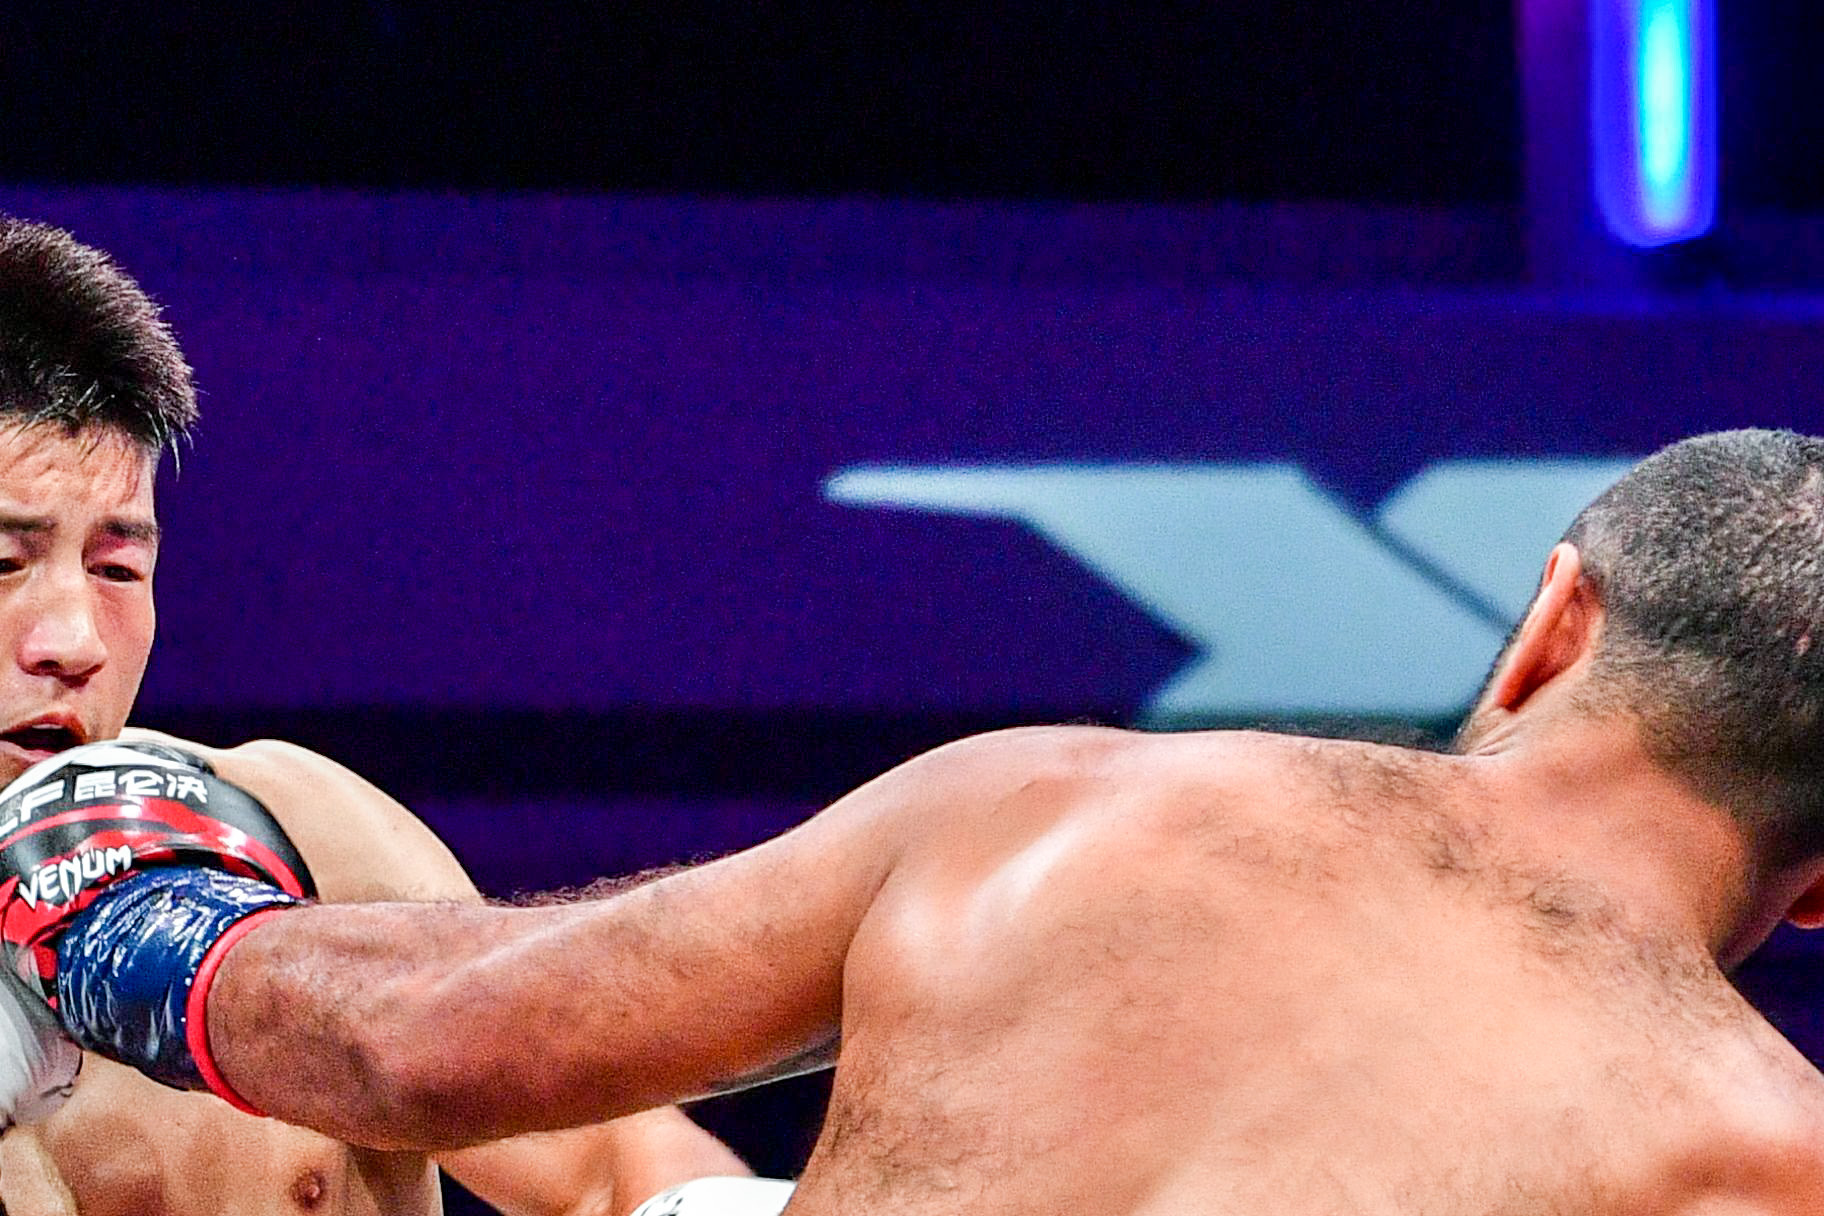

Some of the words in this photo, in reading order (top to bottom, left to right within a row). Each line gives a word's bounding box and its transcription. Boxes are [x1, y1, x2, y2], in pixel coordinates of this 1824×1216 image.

[74, 769, 209, 804] 昆仑决
[19, 845, 132, 909] VENUM
